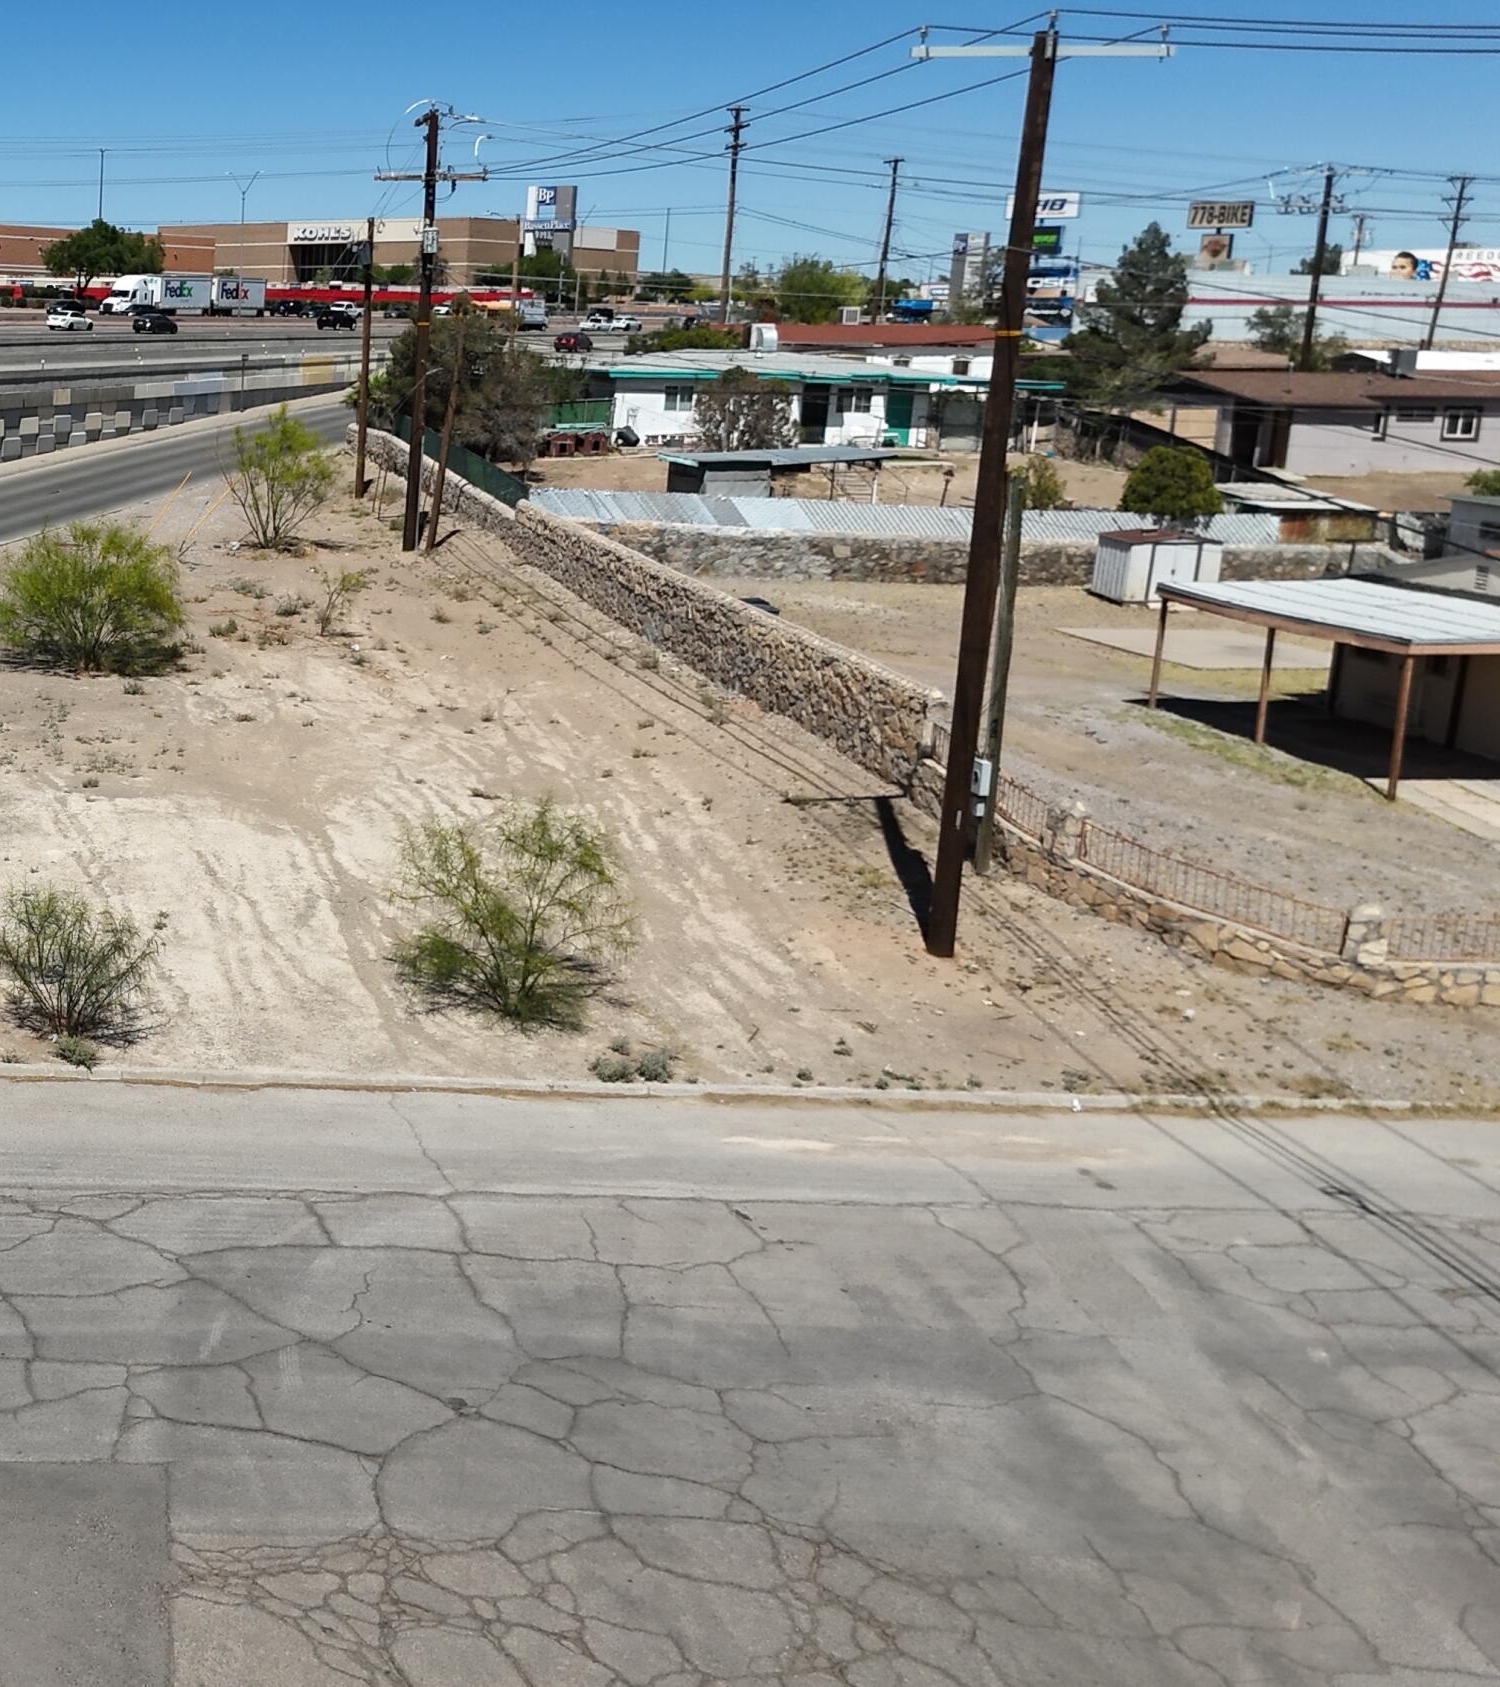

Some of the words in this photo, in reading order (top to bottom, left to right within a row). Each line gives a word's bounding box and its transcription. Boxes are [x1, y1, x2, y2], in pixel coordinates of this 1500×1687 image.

[539, 188, 555, 204] BP
[1190, 205, 1249, 225] 778-BIKE
[294, 226, 351, 241] KOHL'S
[164, 279, 193, 298] FedEx
